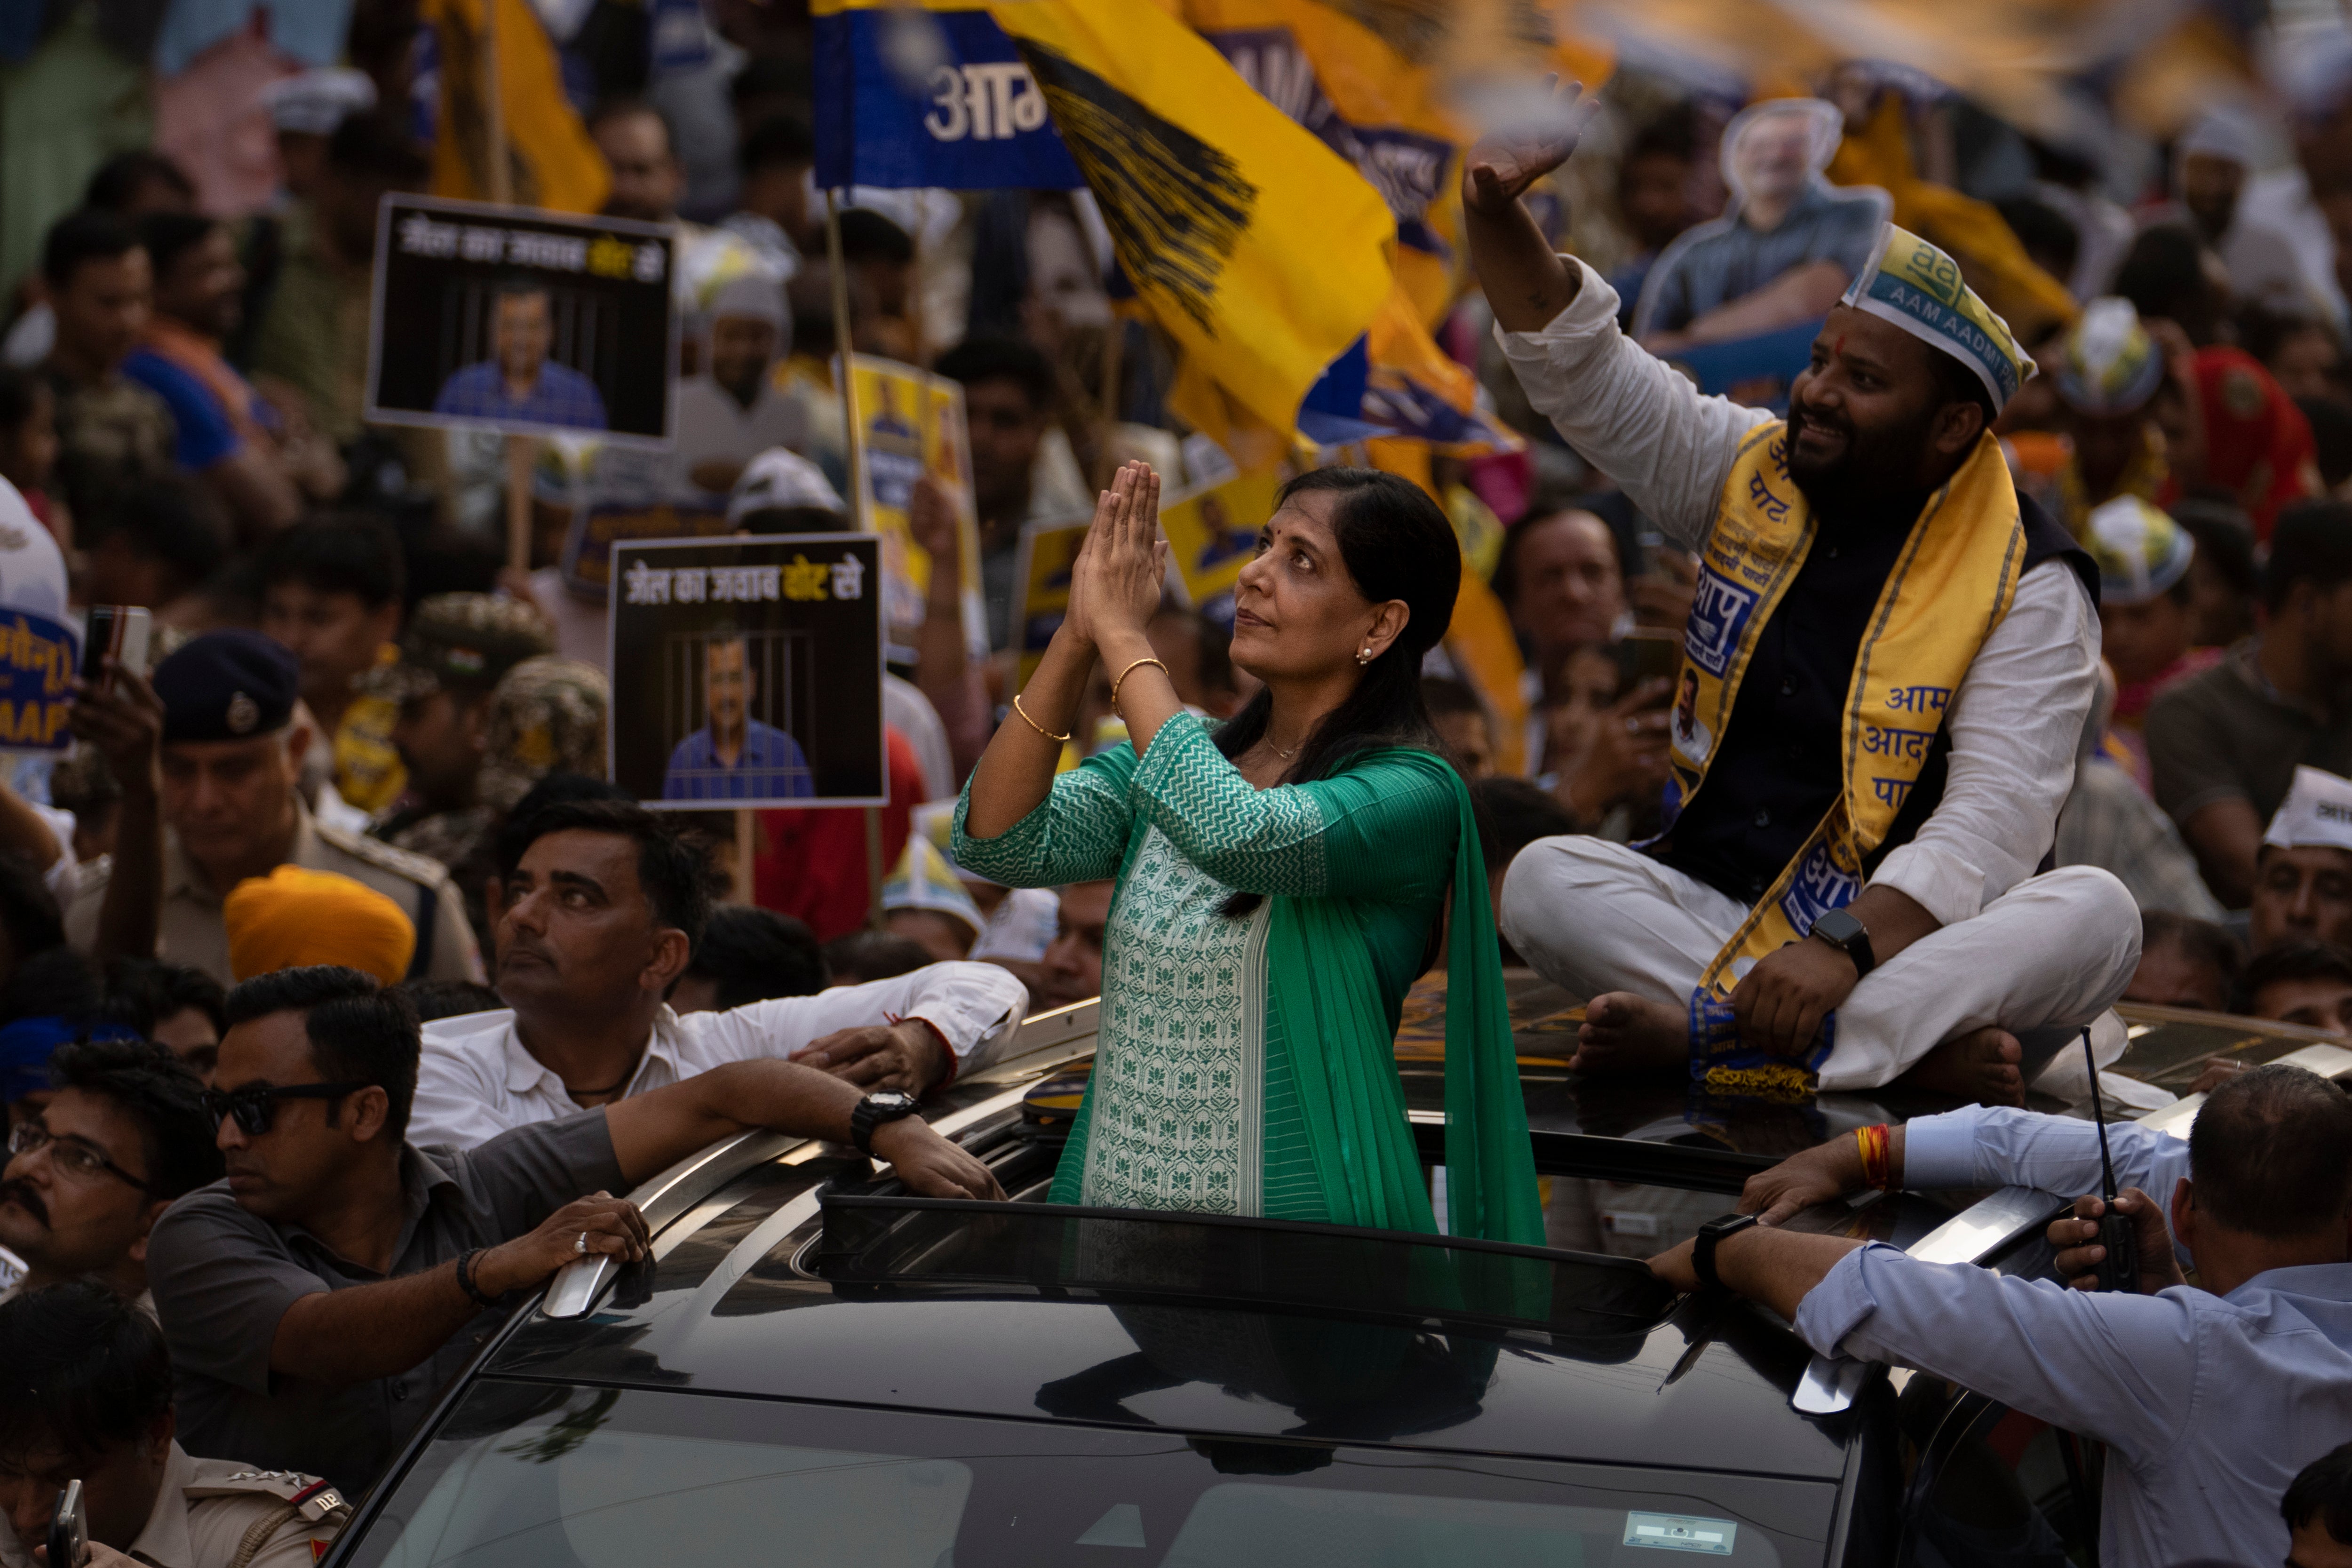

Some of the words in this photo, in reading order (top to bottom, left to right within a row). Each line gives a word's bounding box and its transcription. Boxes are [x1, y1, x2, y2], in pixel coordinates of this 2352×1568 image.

[1890, 286, 1941, 323] AAM
[1943, 316, 2001, 370] AADMI
[624, 558, 670, 605] जेल
[673, 567, 706, 604] का
[707, 565, 781, 602] जवाब
[780, 553, 830, 602] वोट
[831, 552, 866, 601] से
[1696, 565, 1751, 655] आप
[1885, 686, 1952, 717] आम
[1872, 777, 1915, 810] पा
[315, 1493, 341, 1511] DP
